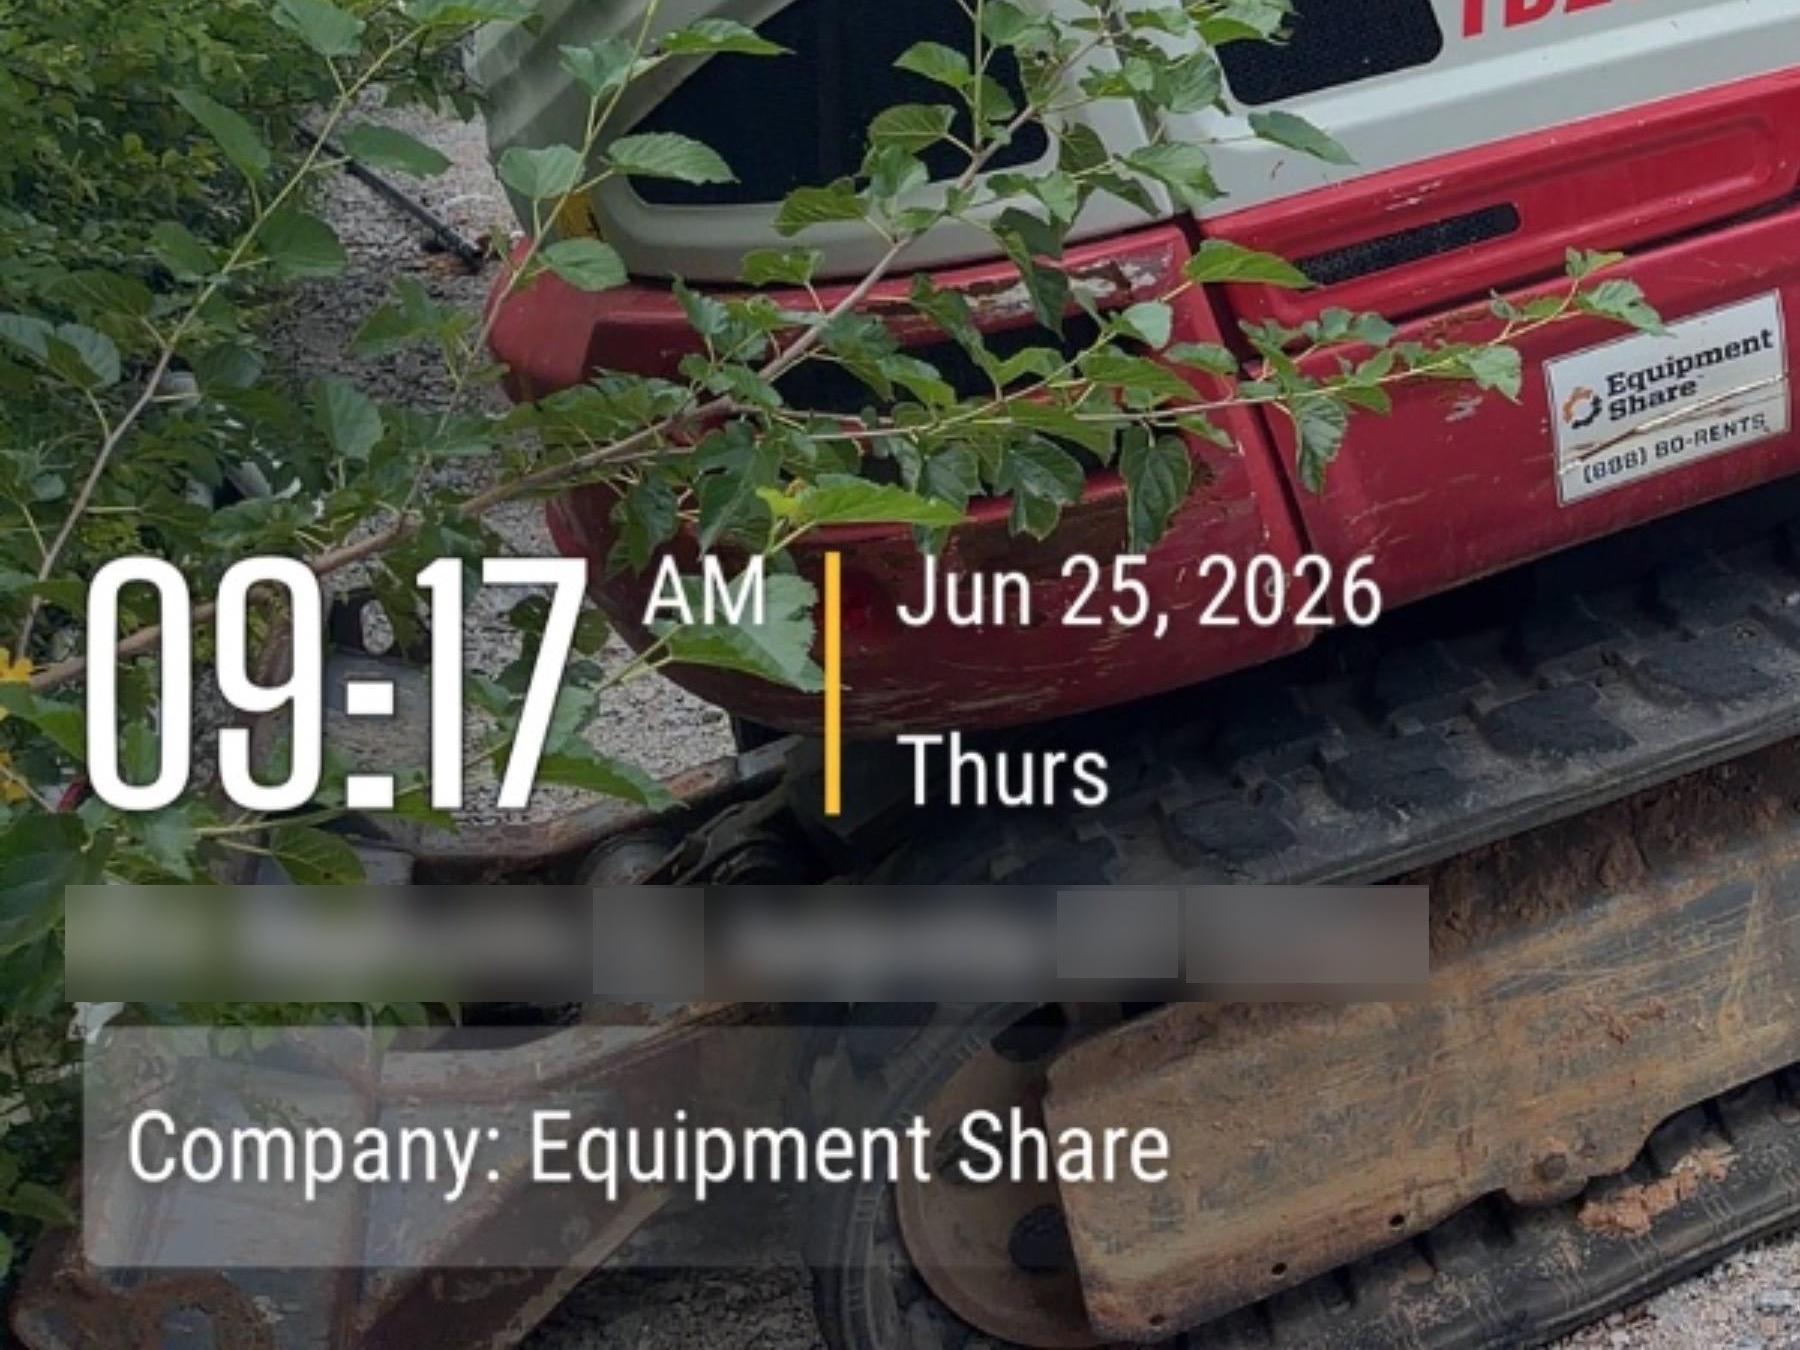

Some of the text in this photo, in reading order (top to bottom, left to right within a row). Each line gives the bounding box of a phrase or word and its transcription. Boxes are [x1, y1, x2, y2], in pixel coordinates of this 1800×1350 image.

[1606, 328, 1774, 396] Equipment
[1608, 380, 1697, 421] Share
[1583, 446, 1648, 483] (888)
